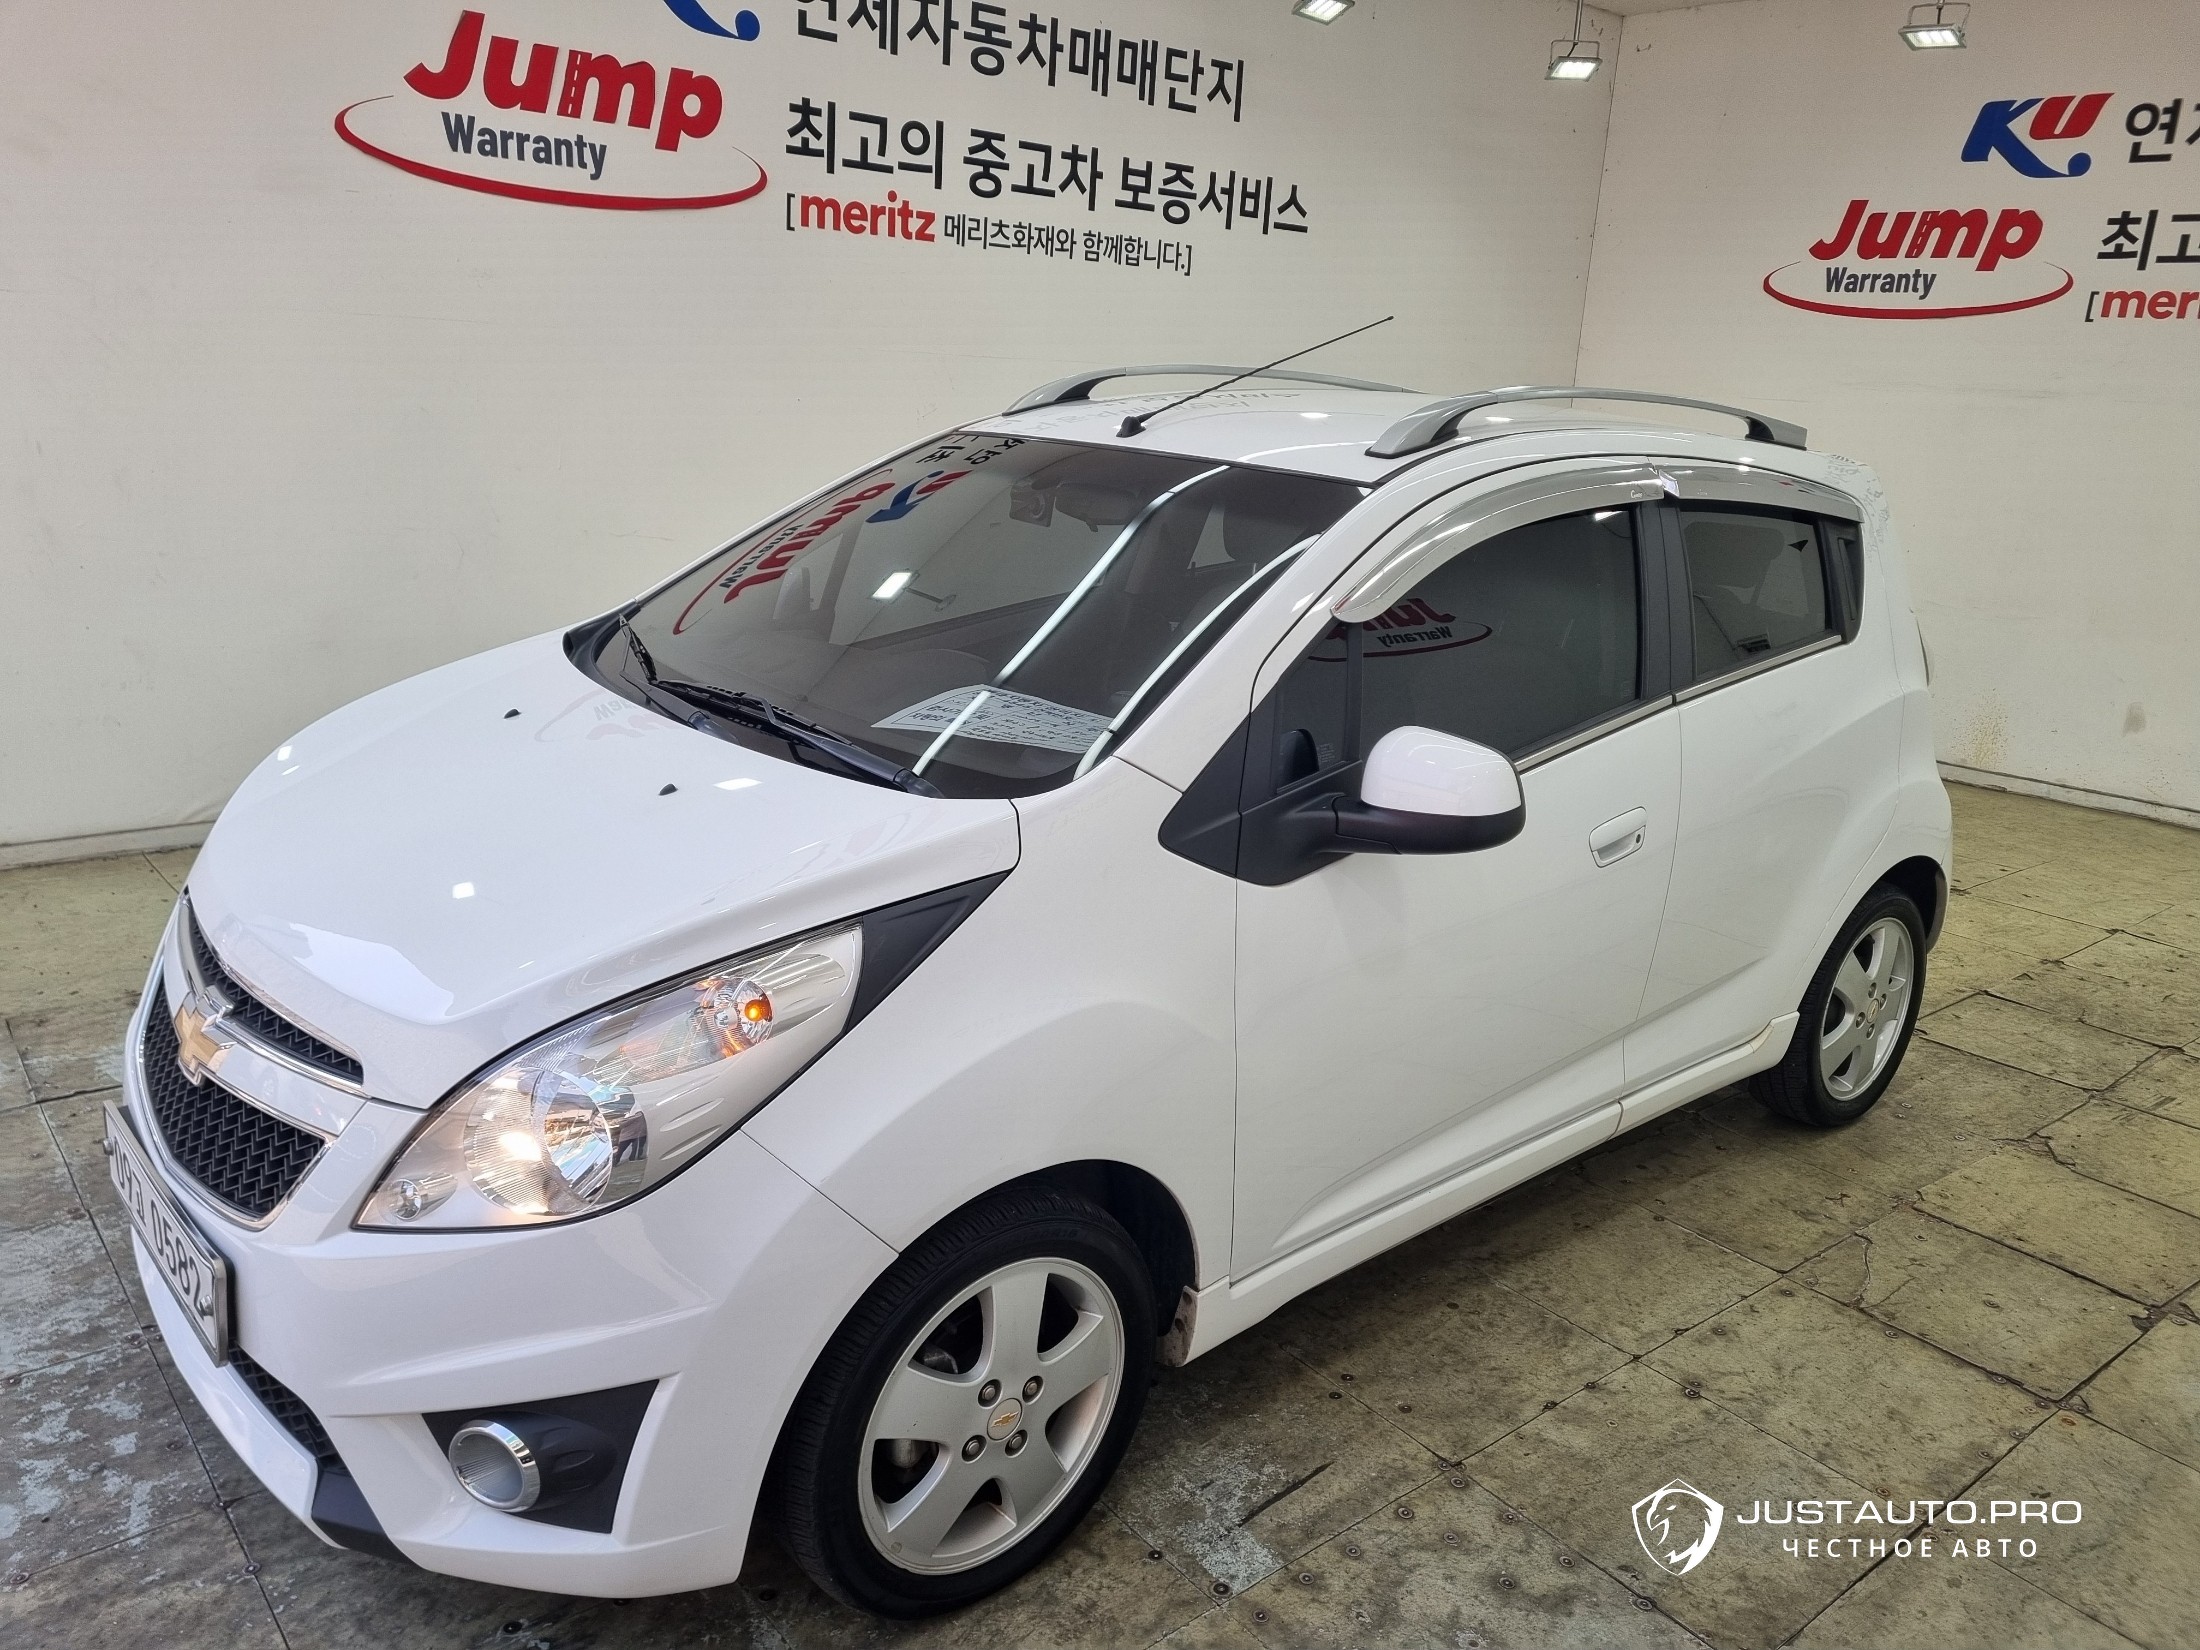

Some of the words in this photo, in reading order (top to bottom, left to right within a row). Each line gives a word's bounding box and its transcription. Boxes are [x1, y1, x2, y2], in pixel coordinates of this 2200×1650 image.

[403, 9, 723, 153] Jump
[441, 111, 607, 180] Warranty
[2125, 98, 2200, 163] 연
[785, 96, 944, 190] 최고의
[962, 127, 1104, 212] 중고차
[1114, 157, 1310, 235] 보증서비스
[943, 213, 1078, 260] 메리츠화재와
[1808, 199, 2044, 272] Jump
[1825, 266, 1937, 300] Warranty
[2085, 289, 2200, 323] [mer
[150, 1199, 205, 1321] 0582
